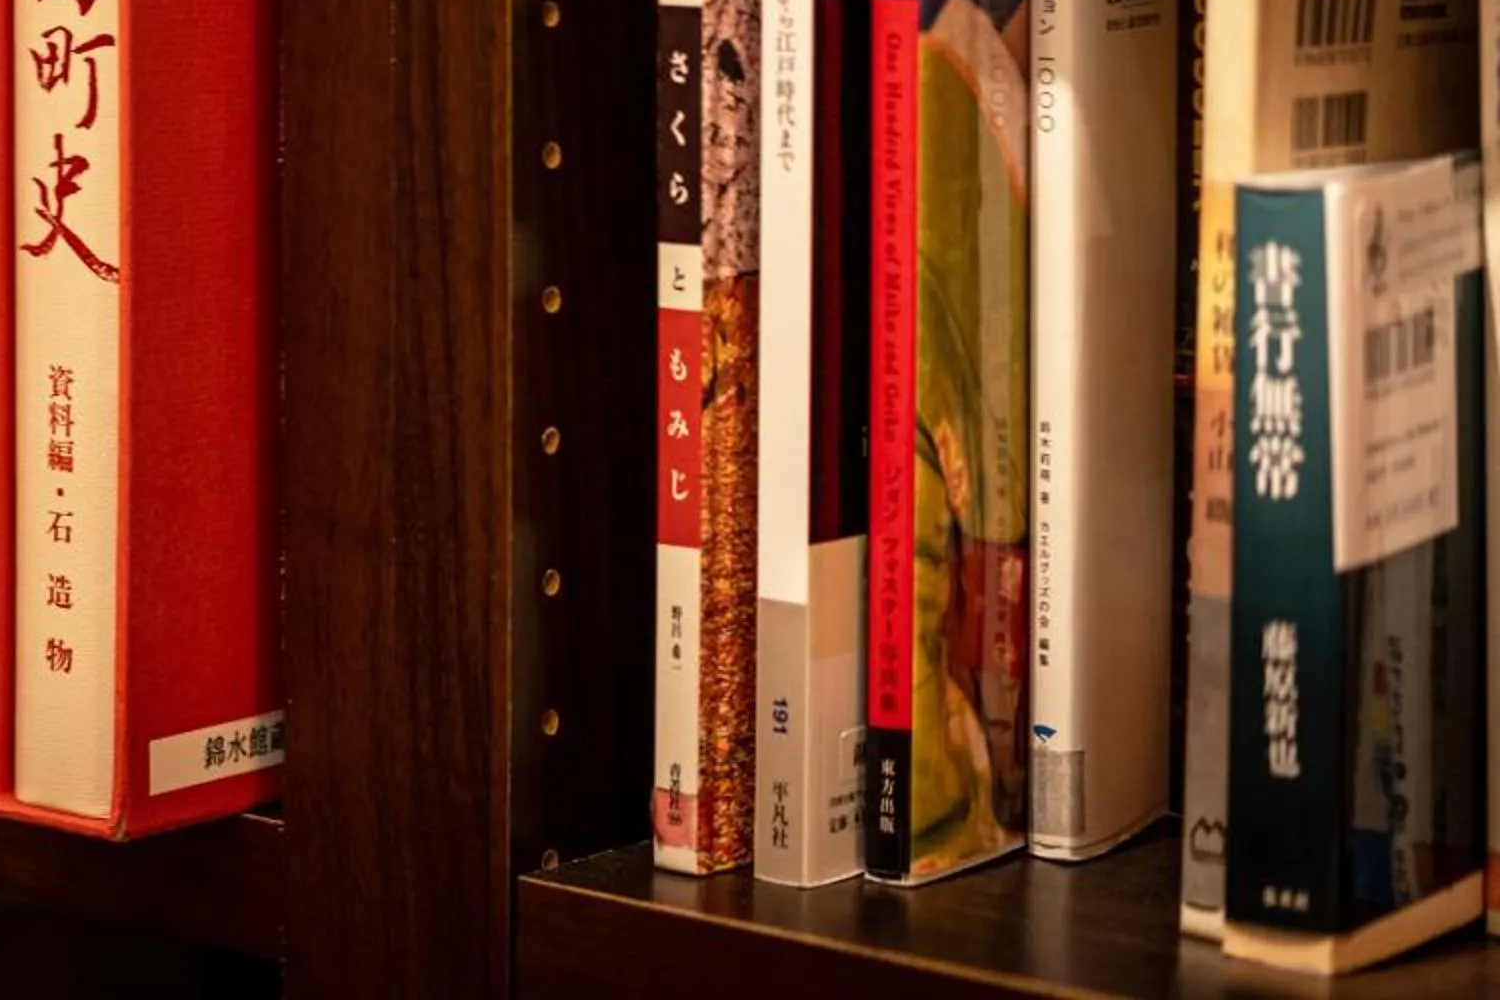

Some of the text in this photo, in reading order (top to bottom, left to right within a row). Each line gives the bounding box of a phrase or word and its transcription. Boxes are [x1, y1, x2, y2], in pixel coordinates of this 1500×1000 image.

[46, 365, 75, 675] 資料編・石造物
[771, 696, 790, 737] 191
[771, 781, 790, 850] 平凡社
[879, 758, 896, 835] 東方出版
